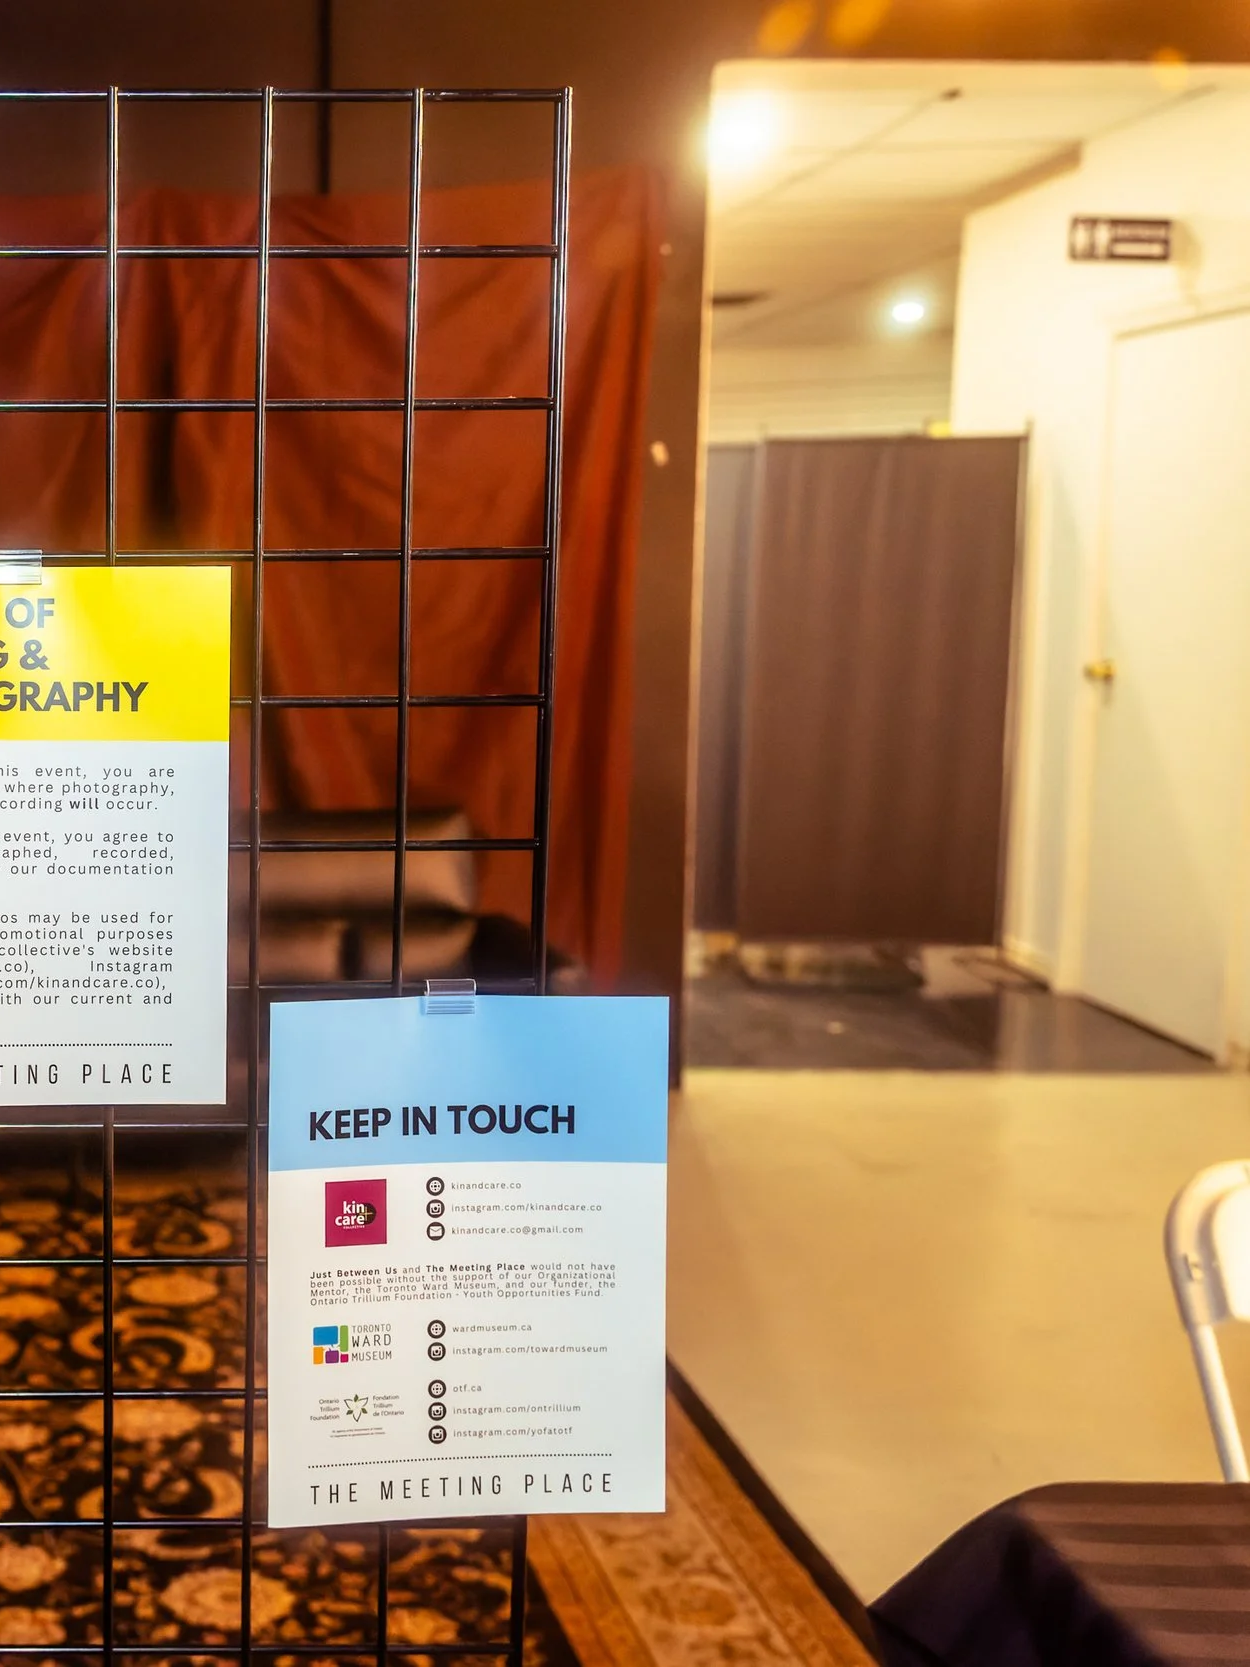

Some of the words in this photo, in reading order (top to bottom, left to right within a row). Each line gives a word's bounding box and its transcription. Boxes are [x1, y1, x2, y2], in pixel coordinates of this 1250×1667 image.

[5, 598, 55, 628] OF
[19, 639, 50, 670] &
[35, 766, 87, 780] event,
[103, 768, 132, 781] you
[148, 768, 175, 778] are
[4, 781, 54, 794] where
[62, 781, 174, 797] photography,
[69, 797, 99, 810] will
[106, 800, 158, 810] occur.
[93, 846, 173, 861] recorded,
[10, 865, 38, 875] our
[46, 862, 173, 875] documentation
[28, 914, 61, 927] may
[71, 911, 90, 924] be
[101, 911, 139, 924] used
[149, 911, 174, 924] for
[97, 930, 173, 943] purposes
[90, 960, 172, 976] Instagram
[33, 995, 60, 1005] our
[70, 993, 133, 1005] current
[143, 992, 172, 1005] and
[82, 1063, 172, 1084] PLACE
[309, 1109, 391, 1141] KEEP
[402, 1106, 437, 1136] IN
[447, 1105, 575, 1134] TOUCH
[451, 1181, 522, 1190] kinandcare.co
[343, 1201, 365, 1214] kin
[451, 1203, 602, 1214] instagram.com/kinandcare.co
[335, 1215, 365, 1226] care
[451, 1225, 583, 1236] kinandcare.co@gmail.com
[310, 1271, 332, 1279] Just
[337, 1268, 380, 1277] Between
[385, 1267, 398, 1275] Us
[402, 1265, 421, 1274] and
[426, 1265, 444, 1273] The
[449, 1263, 492, 1273] Meeting
[497, 1263, 526, 1271] Place
[530, 1262, 562, 1271] would
[567, 1263, 585, 1271] not
[590, 1262, 616, 1271] have
[310, 1297, 348, 1306] Ontario
[352, 1294, 391, 1303] Trillium
[394, 1292, 452, 1301] Foundation
[464, 1289, 493, 1298] Youth
[497, 1288, 571, 1299] Opportunities
[352, 1324, 391, 1333] TORONTO
[452, 1324, 532, 1333] wardmuseum.ca
[352, 1335, 392, 1348] WARD
[352, 1350, 392, 1362] MUSEUM
[452, 1345, 608, 1356] instagram.com/towardmuseum
[452, 1384, 482, 1393] otf.ca
[453, 1404, 581, 1416] instagram.com/ontrillium
[453, 1426, 573, 1439] instagram.com/yofatotf
[310, 1482, 358, 1505] THE
[380, 1475, 501, 1501] MEETING
[524, 1473, 612, 1494] PLACE
